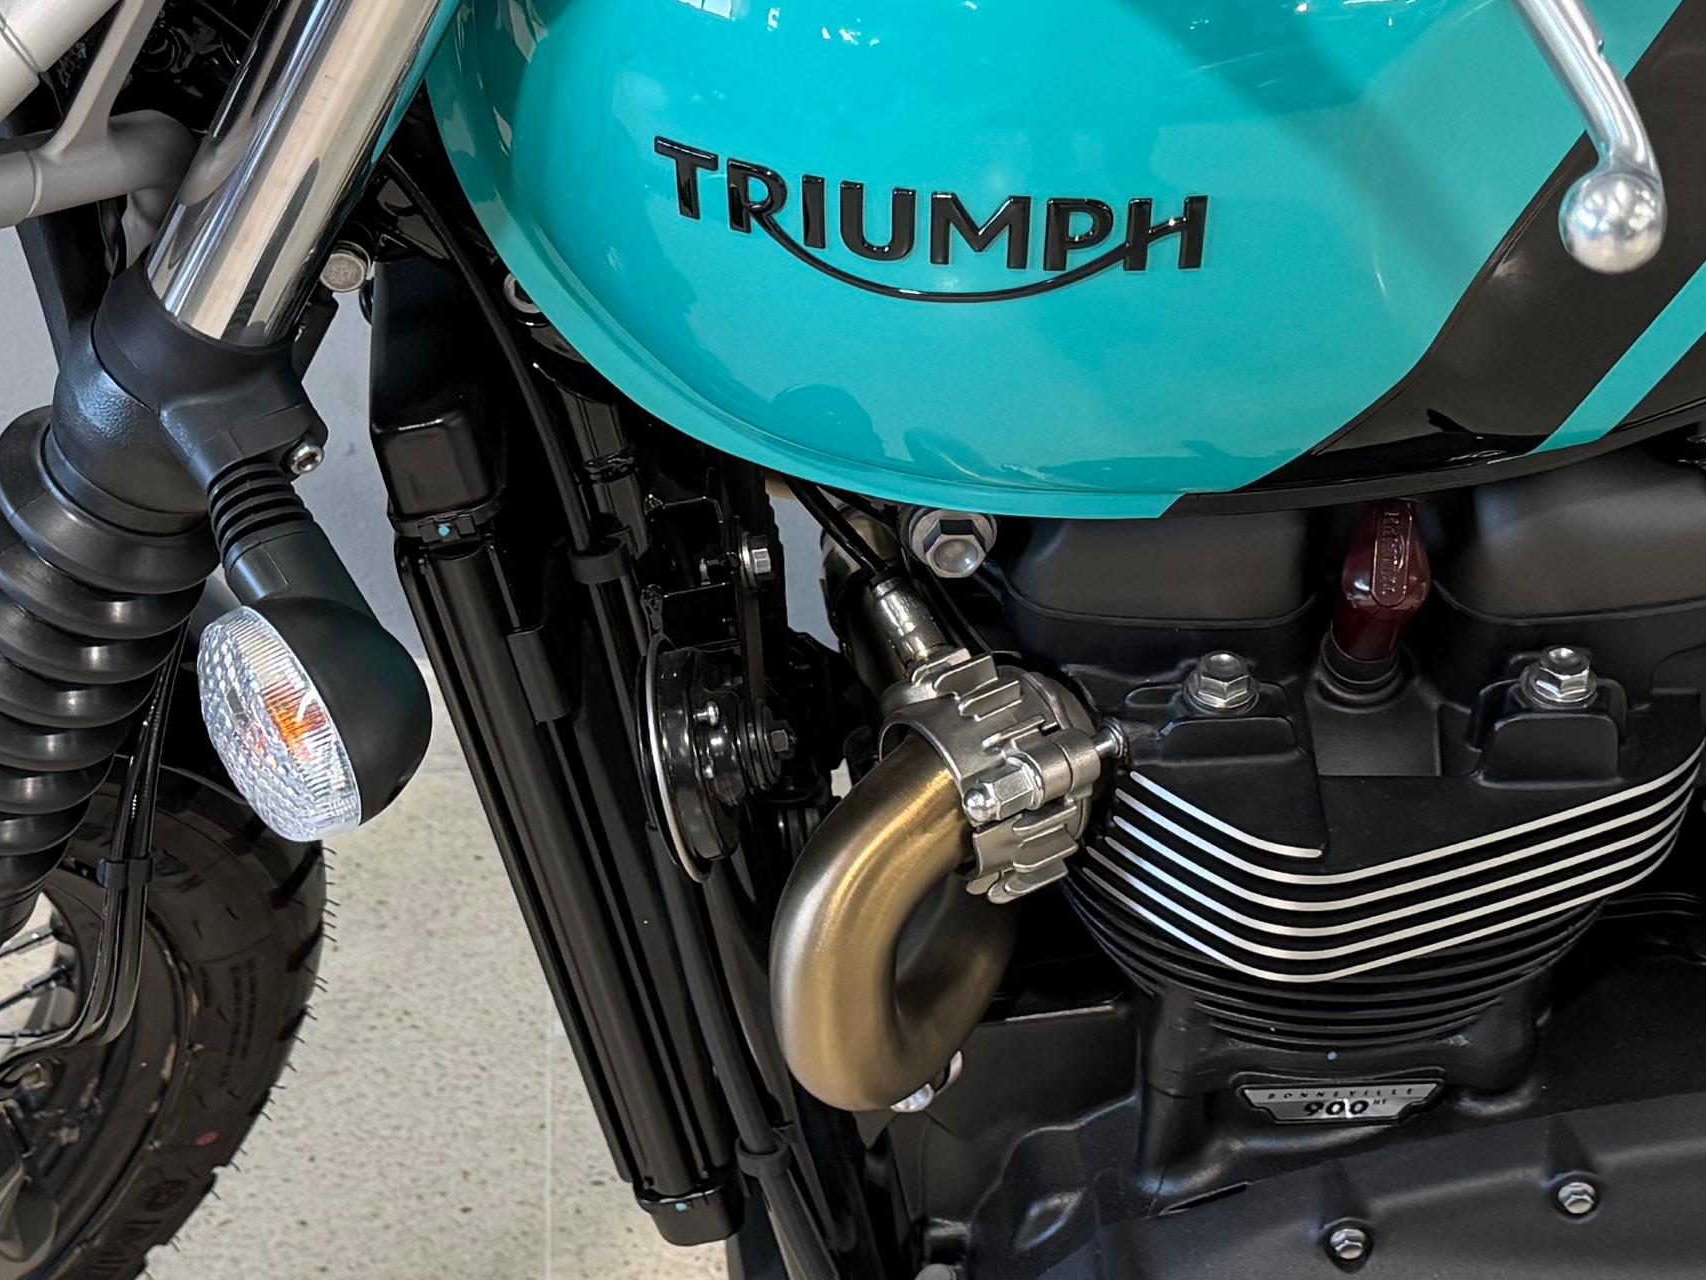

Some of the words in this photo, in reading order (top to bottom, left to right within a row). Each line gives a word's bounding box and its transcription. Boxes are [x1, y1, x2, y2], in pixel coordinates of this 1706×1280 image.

[653, 135, 1209, 303] TRIUMPH
[1267, 1087, 1414, 1100] BONNEVILLE
[1303, 1099, 1369, 1117] 900
